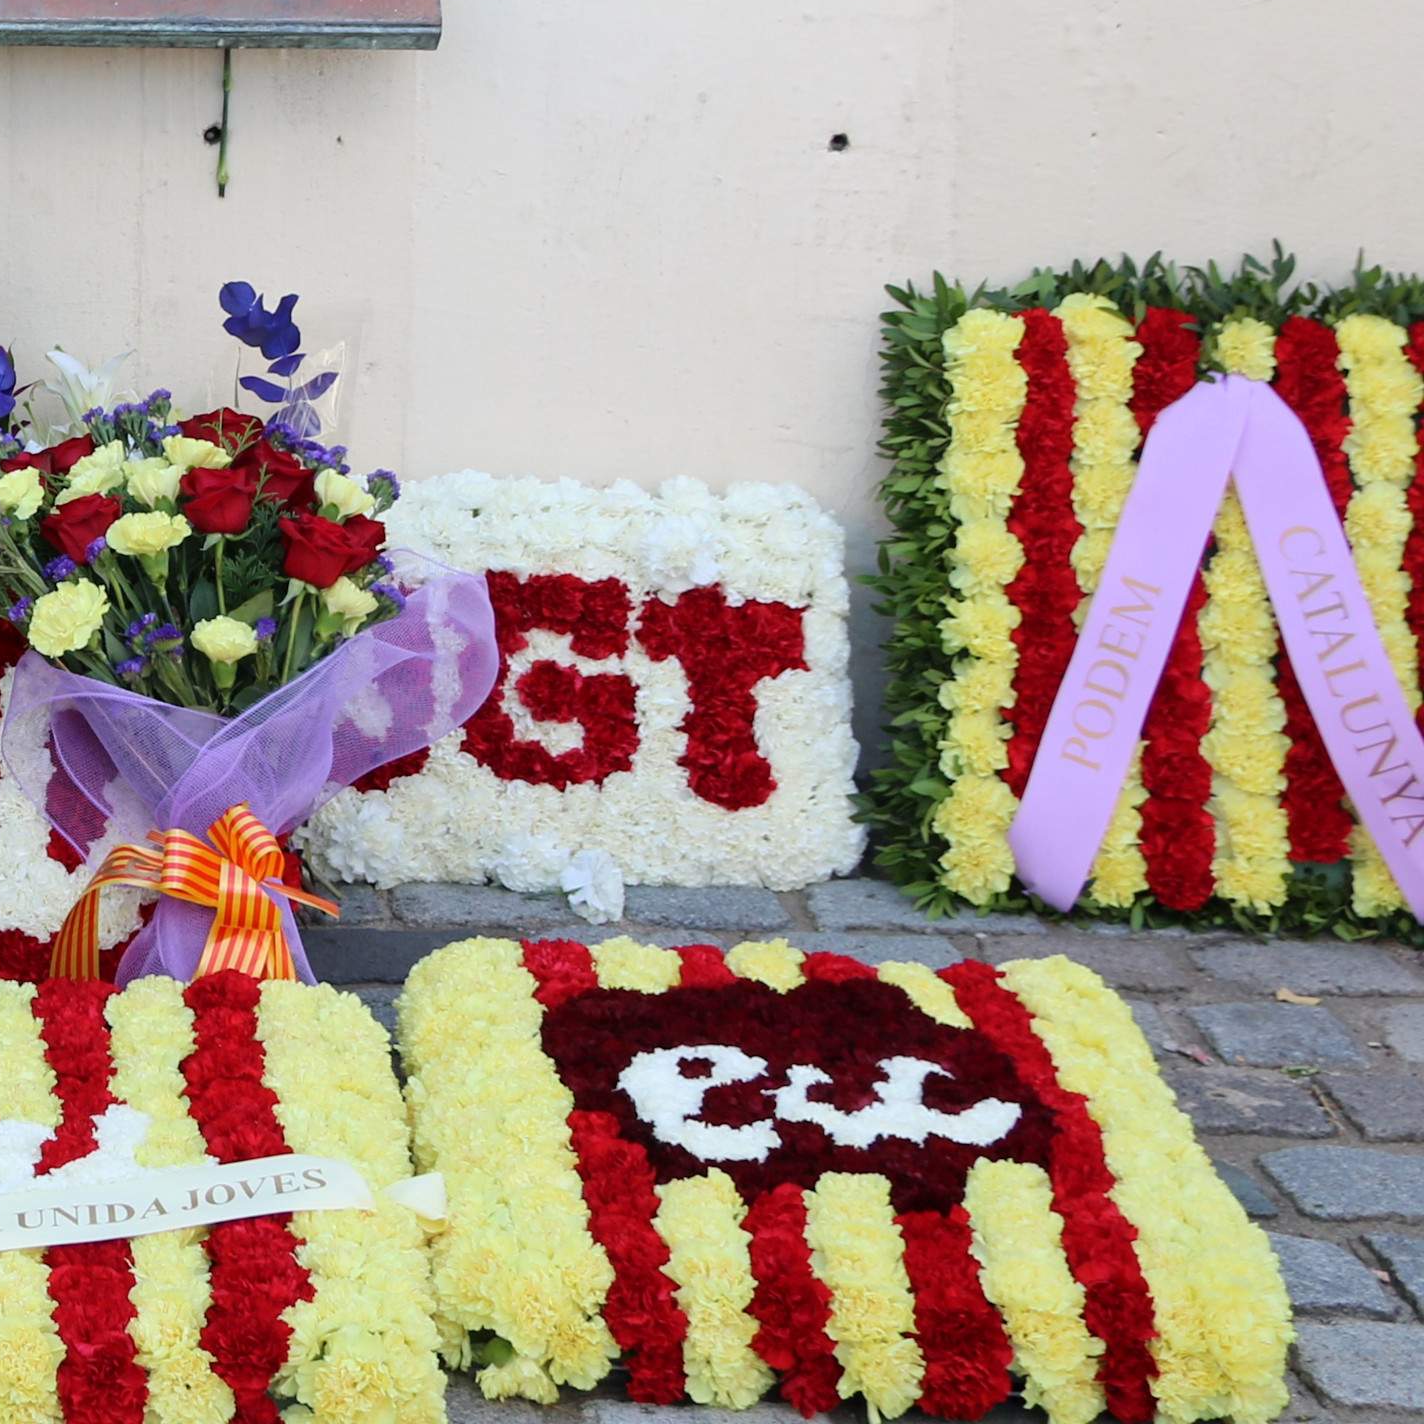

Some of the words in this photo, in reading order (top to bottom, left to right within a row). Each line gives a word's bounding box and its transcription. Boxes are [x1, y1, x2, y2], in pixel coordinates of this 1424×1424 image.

[1060, 574, 1163, 773] PODEM
[14, 1195, 167, 1231] UNIDA
[181, 1167, 329, 1212] JOVES
